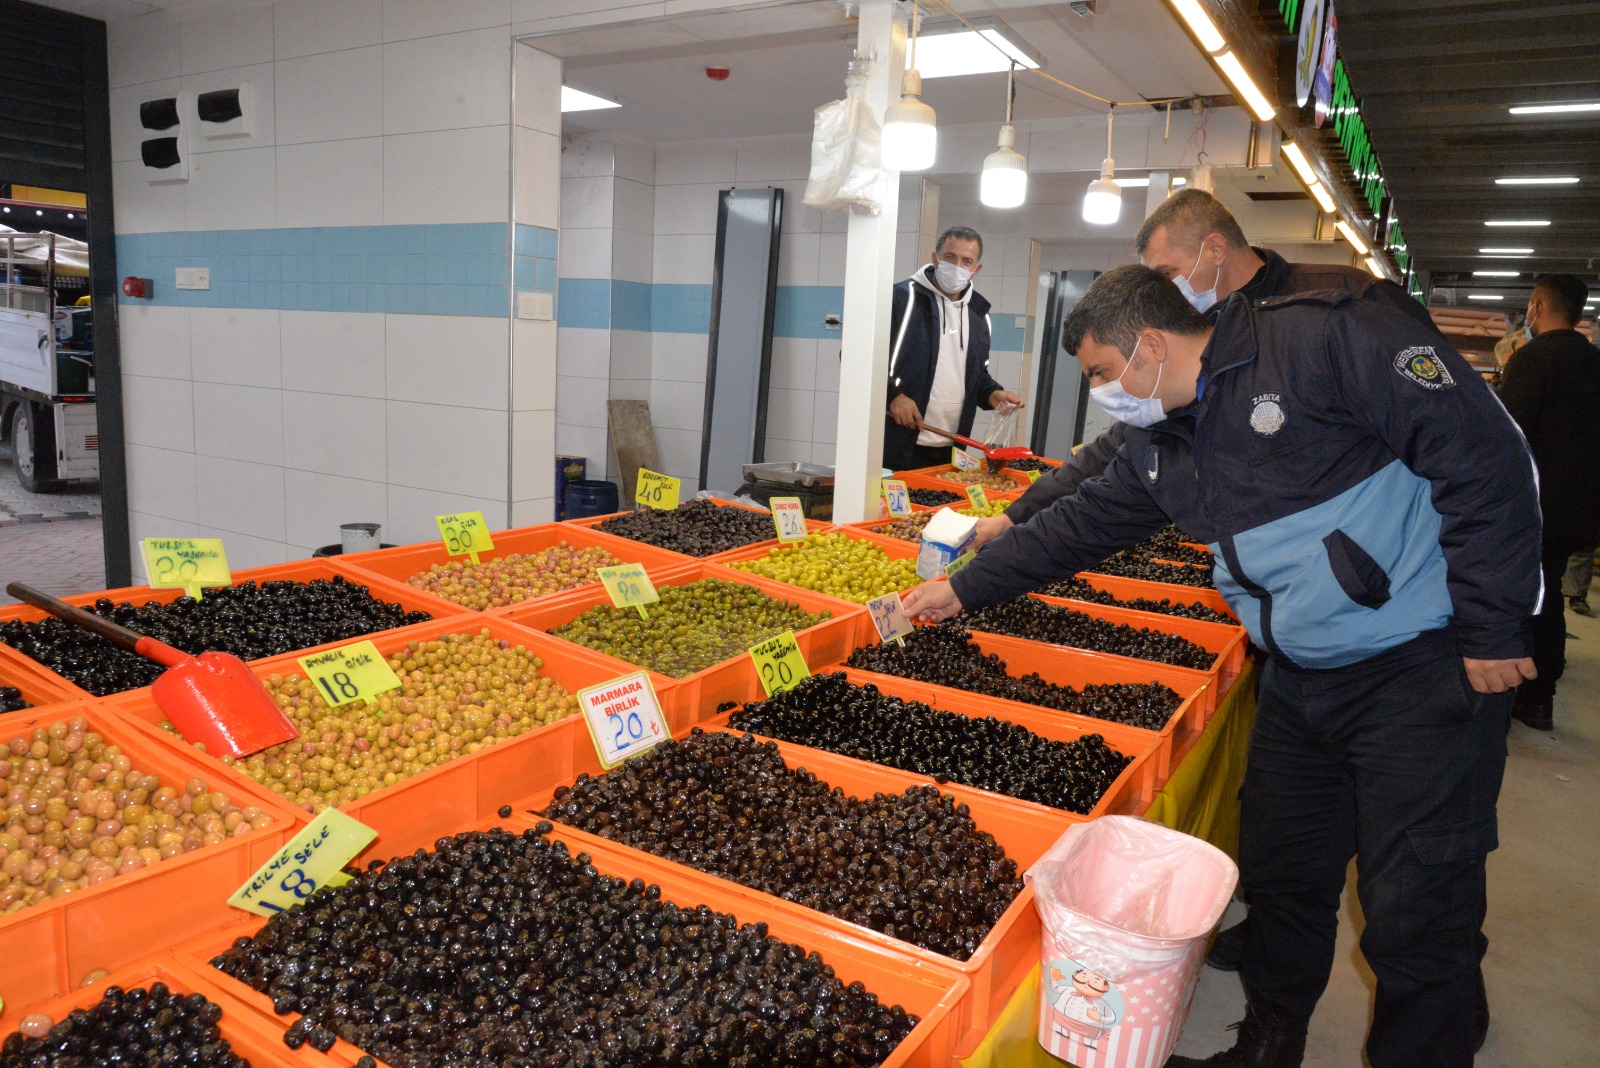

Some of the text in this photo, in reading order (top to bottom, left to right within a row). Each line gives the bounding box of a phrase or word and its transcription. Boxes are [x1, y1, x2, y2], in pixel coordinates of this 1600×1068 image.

[1252, 393, 1281, 405] ZABITA
[638, 482, 662, 502] 40
[888, 492, 903, 512] 24
[782, 513, 798, 536] 26
[445, 527, 472, 552] 30
[156, 556, 199, 584] 20
[875, 614, 898, 640] 22
[318, 672, 359, 704] 18
[762, 661, 793, 694] 20
[590, 681, 643, 707] MARMARA
[604, 696, 640, 717] BİRLİK
[609, 712, 643, 751] 20
[258, 868, 317, 912] 18
